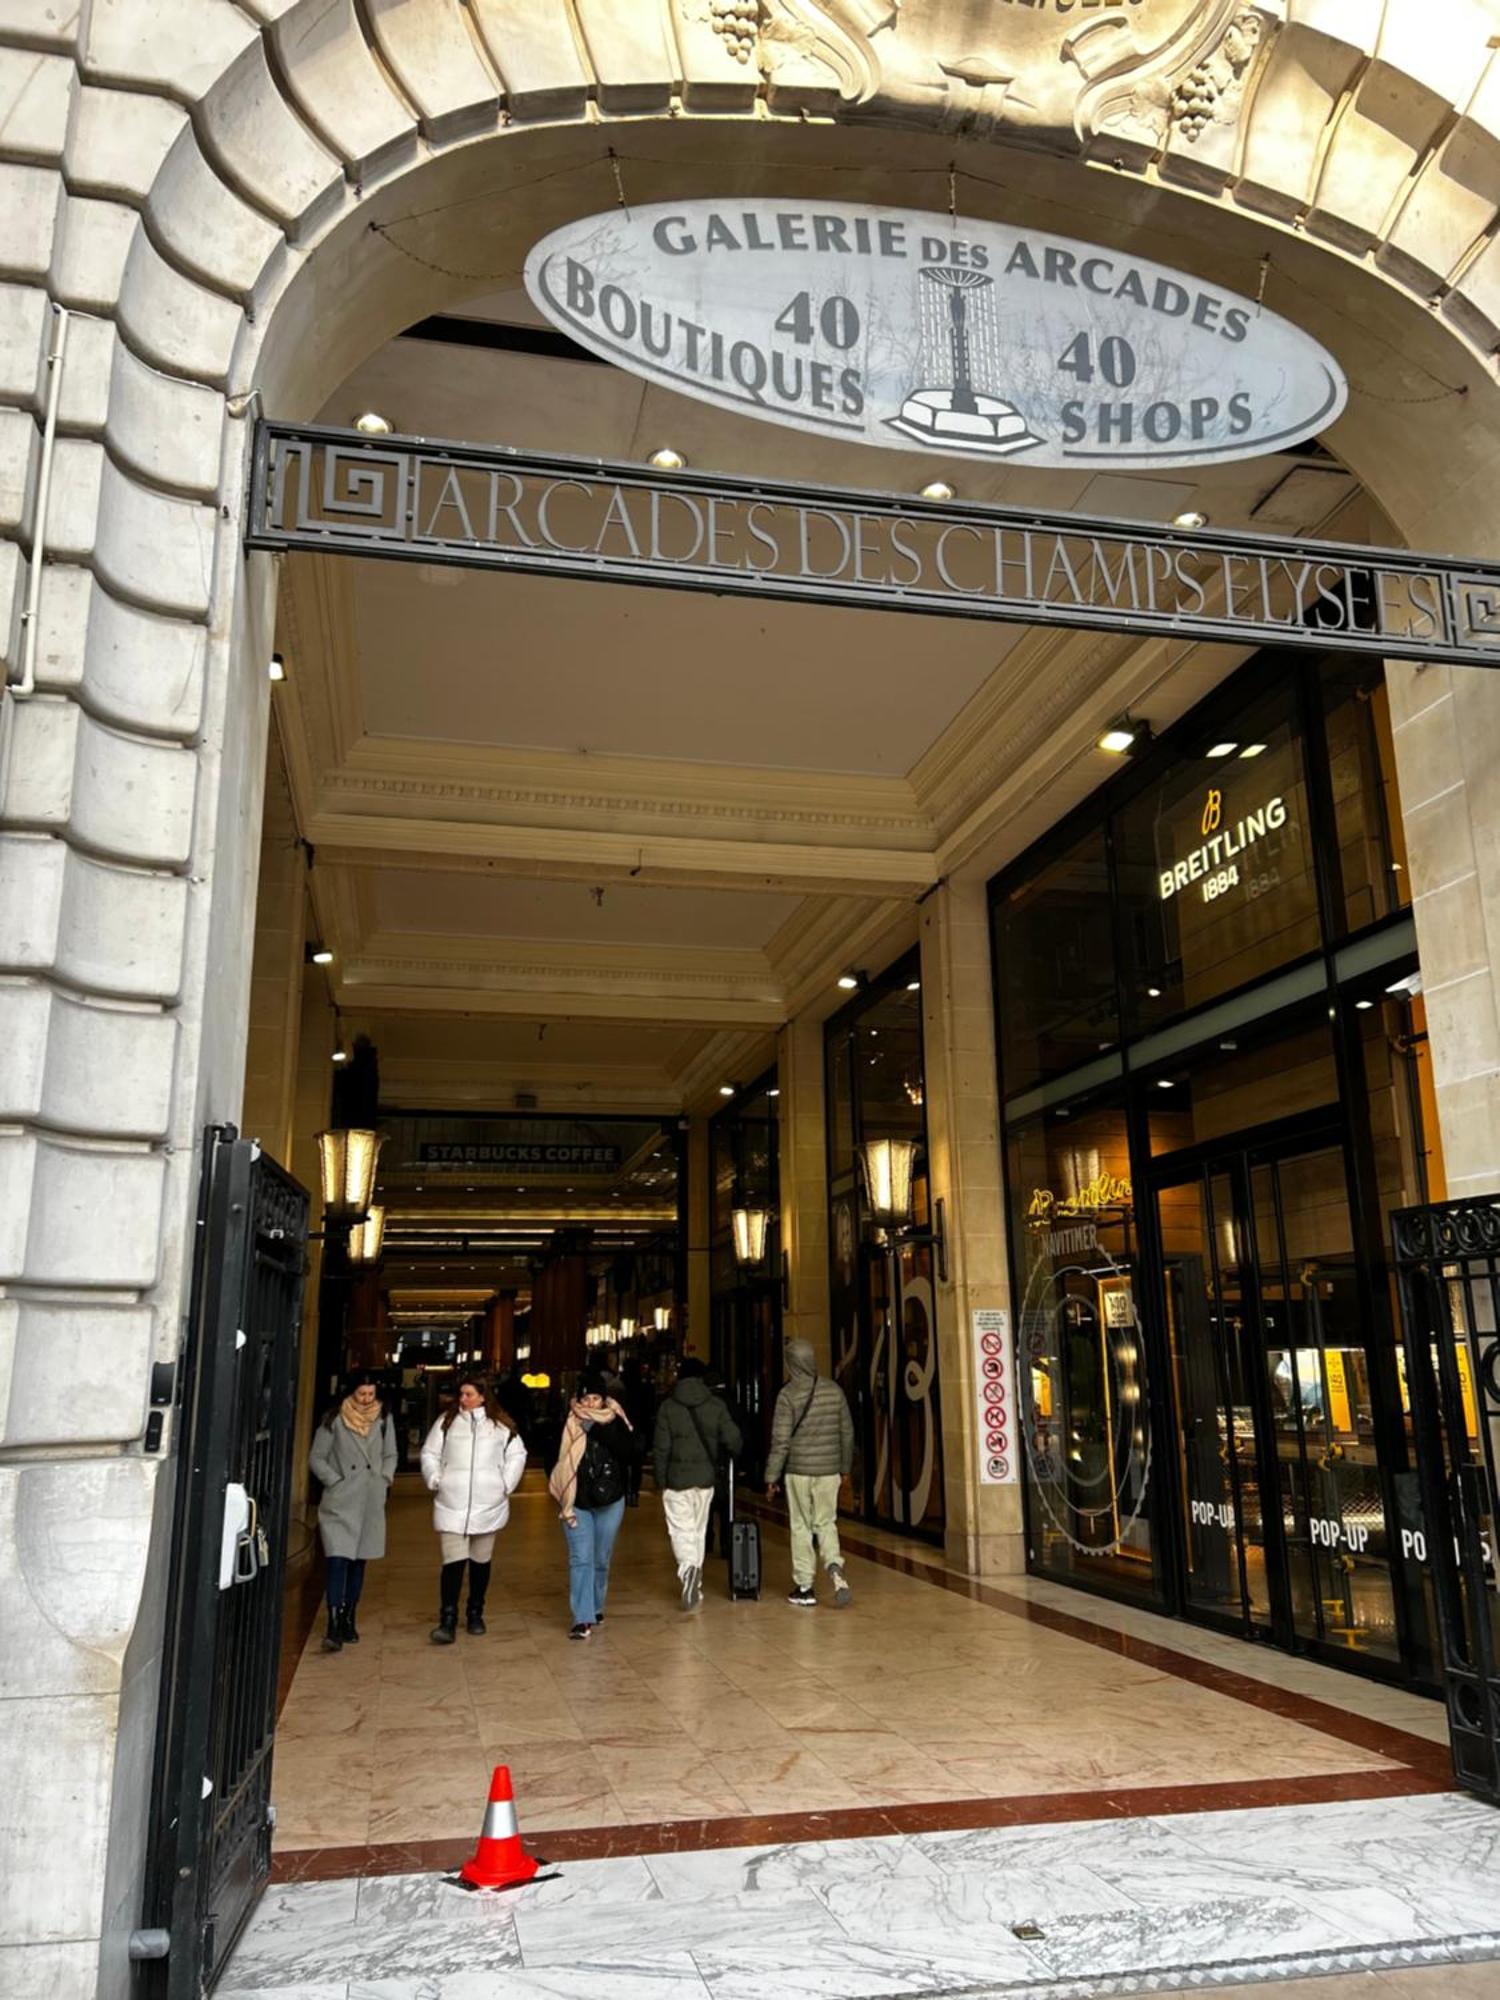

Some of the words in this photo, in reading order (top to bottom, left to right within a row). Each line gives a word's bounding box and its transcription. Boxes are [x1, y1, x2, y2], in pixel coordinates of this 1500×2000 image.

[652, 212, 907, 257] GALERIE
[921, 236, 990, 270] DES
[1004, 241, 1251, 343] ARCADES
[566, 256, 865, 418] BOUTIQUES
[774, 290, 861, 351] 40
[1057, 331, 1137, 389] 40
[1060, 391, 1253, 444] SHOPS
[425, 464, 781, 574] ARCADES
[800, 507, 922, 587] DES
[935, 522, 1205, 616] CHAMPS
[1220, 552, 1442, 641] ELYSEES
[1159, 796, 1287, 900] BREITLING
[1202, 863, 1240, 904] 1884
[426, 1144, 542, 1161] STARBUCKS
[545, 1146, 616, 1162] COFFEE
[1038, 1223, 1098, 1259] NAVITIMER
[1309, 1516, 1369, 1554] POP-UP
